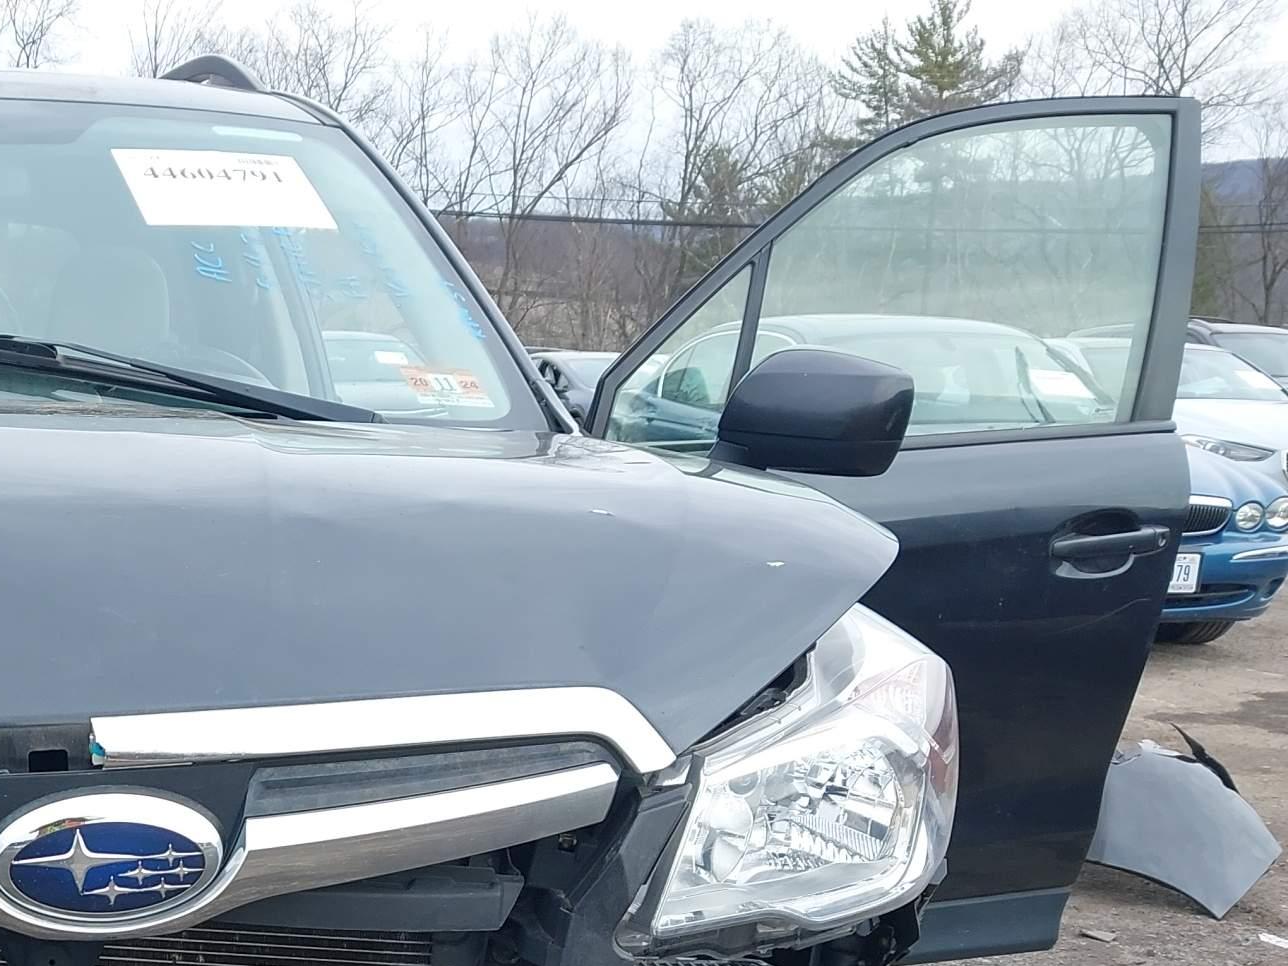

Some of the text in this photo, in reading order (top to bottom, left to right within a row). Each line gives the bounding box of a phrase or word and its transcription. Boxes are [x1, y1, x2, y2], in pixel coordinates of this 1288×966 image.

[410, 377, 429, 387] 20
[434, 377, 456, 392] 11
[1176, 564, 1191, 582] 79
